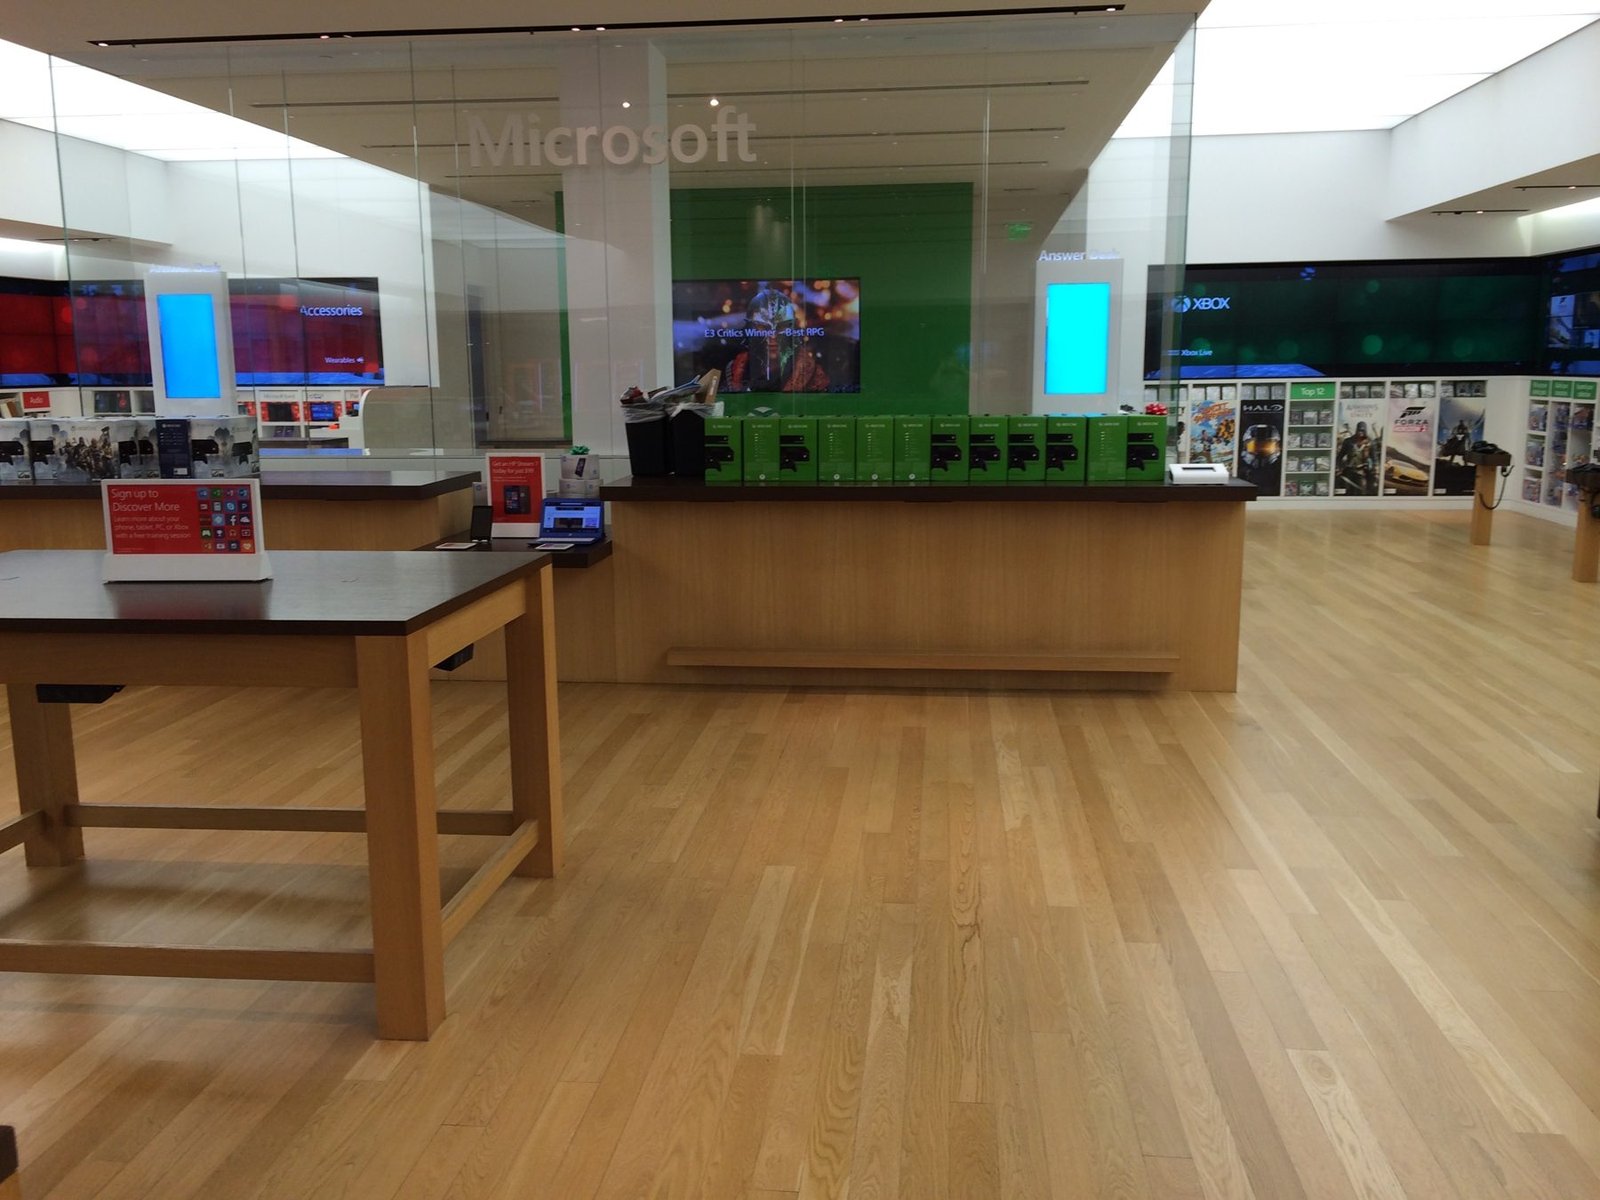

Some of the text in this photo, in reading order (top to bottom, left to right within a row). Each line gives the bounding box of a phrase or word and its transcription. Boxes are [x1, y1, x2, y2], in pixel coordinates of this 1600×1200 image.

[466, 104, 758, 168] Microsoft
[1038, 250, 1086, 261] Answer
[1192, 296, 1231, 310] XBOX
[300, 303, 364, 317] Accessories
[704, 328, 715, 338] E3
[717, 327, 744, 338] Critics
[745, 327, 776, 338] Winner
[786, 327, 804, 337] Best
[806, 327, 825, 337] RPG
[1301, 387, 1326, 397] Top 12
[1242, 403, 1285, 413] HALO
[1394, 418, 1429, 426] FORZA
[111, 488, 159, 501] Sign up to
[112, 502, 181, 512] Discover More
